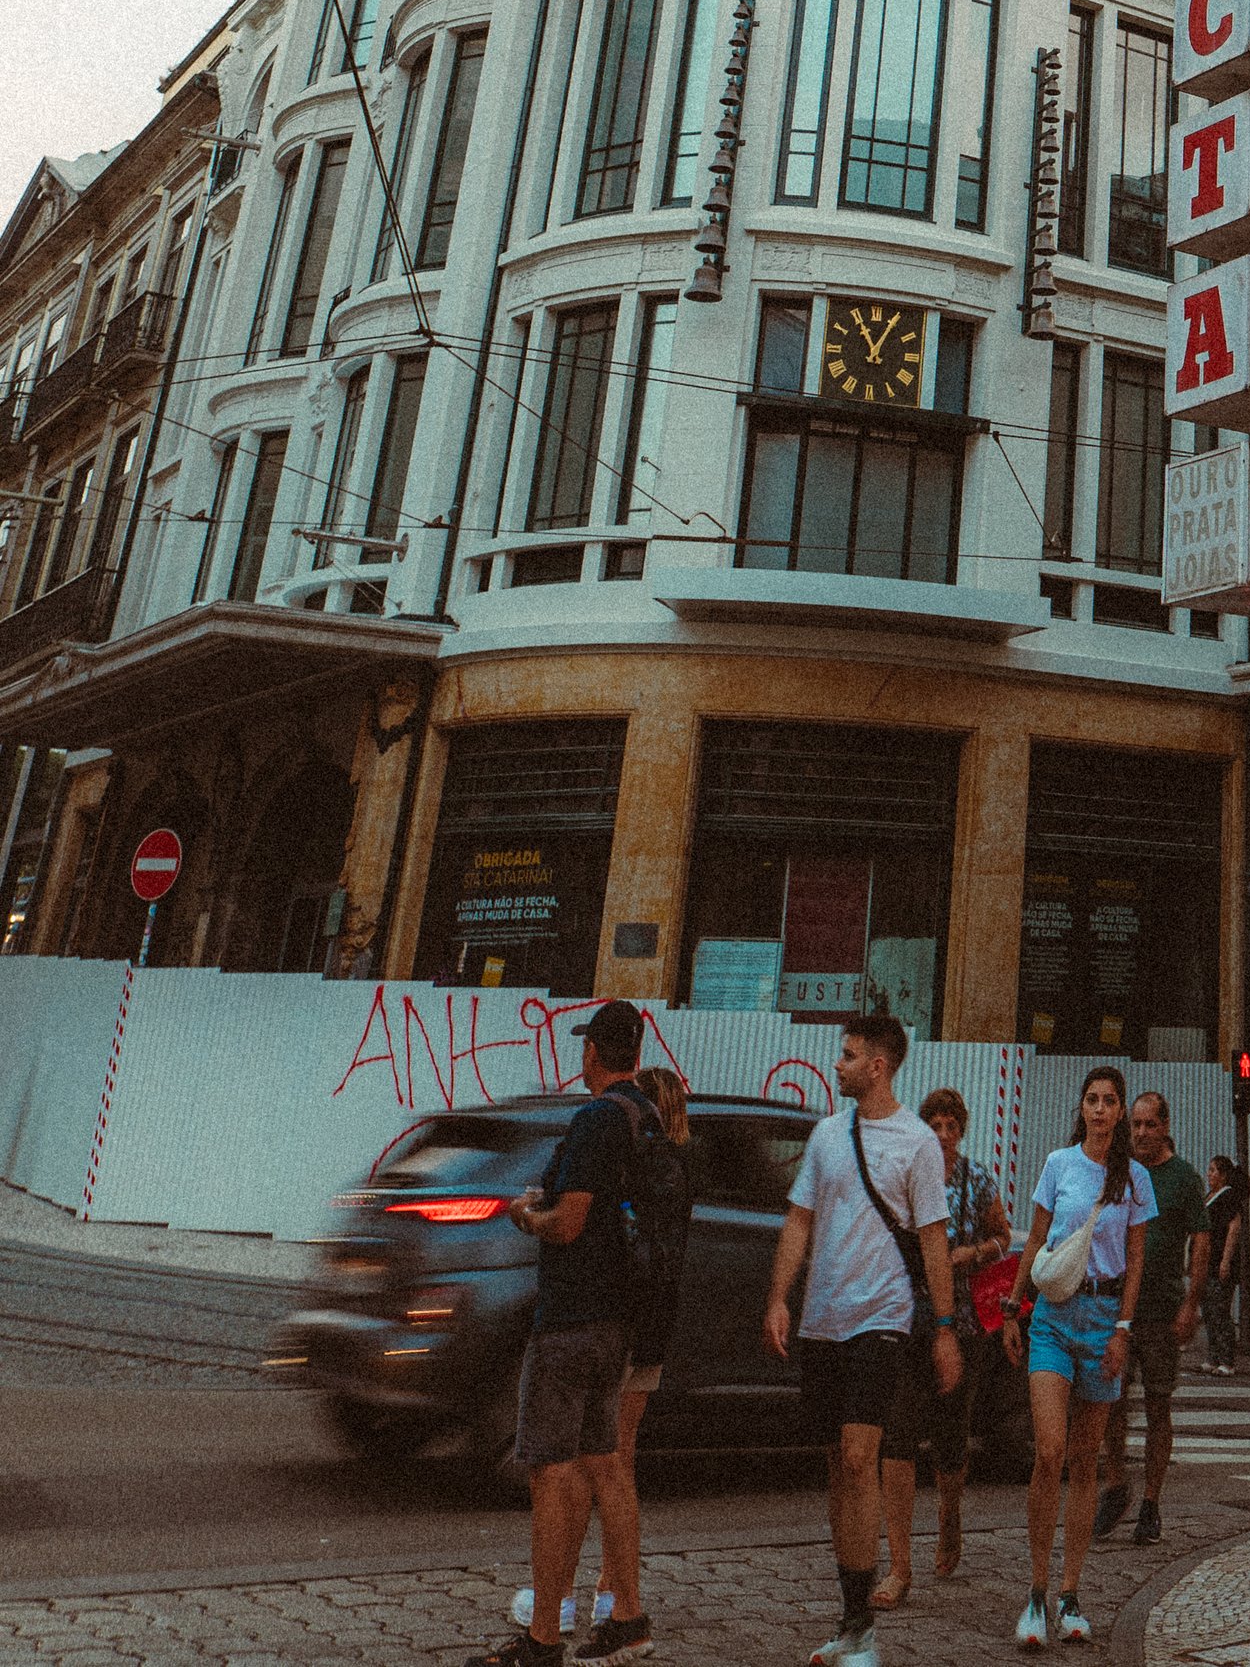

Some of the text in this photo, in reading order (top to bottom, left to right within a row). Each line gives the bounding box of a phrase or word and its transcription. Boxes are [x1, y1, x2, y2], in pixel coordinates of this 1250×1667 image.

[1171, 454, 1239, 505] OURO
[1169, 497, 1239, 550] PRATA
[1169, 543, 1237, 590] JOIAS
[474, 849, 542, 869] OBRIGADA
[461, 898, 493, 911] CULTURA
[494, 895, 513, 909] NÃO
[525, 895, 560, 909] FECHA,
[485, 909, 509, 921] MUDA
[511, 908, 522, 920] DE
[523, 907, 552, 920] CASA.
